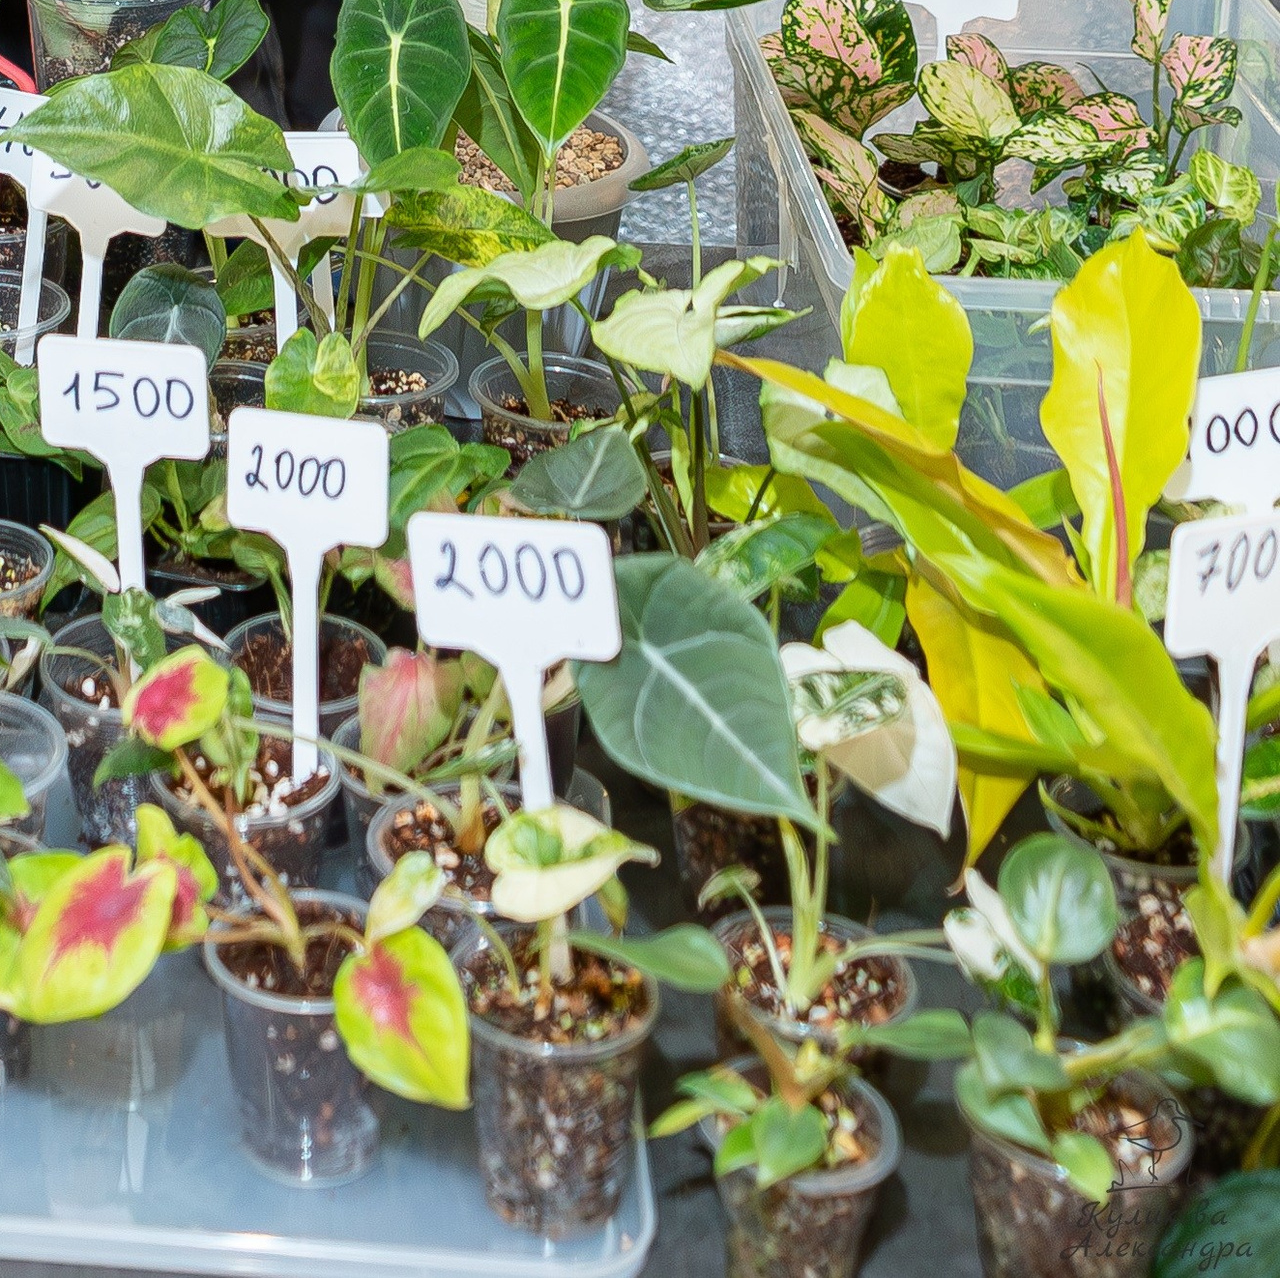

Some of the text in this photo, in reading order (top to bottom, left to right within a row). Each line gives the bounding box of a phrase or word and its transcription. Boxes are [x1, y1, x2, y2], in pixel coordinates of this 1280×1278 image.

[62, 370, 195, 420] 1500
[245, 444, 346, 499] 2000
[434, 539, 586, 602] 2000
[1196, 528, 1278, 596] 700
